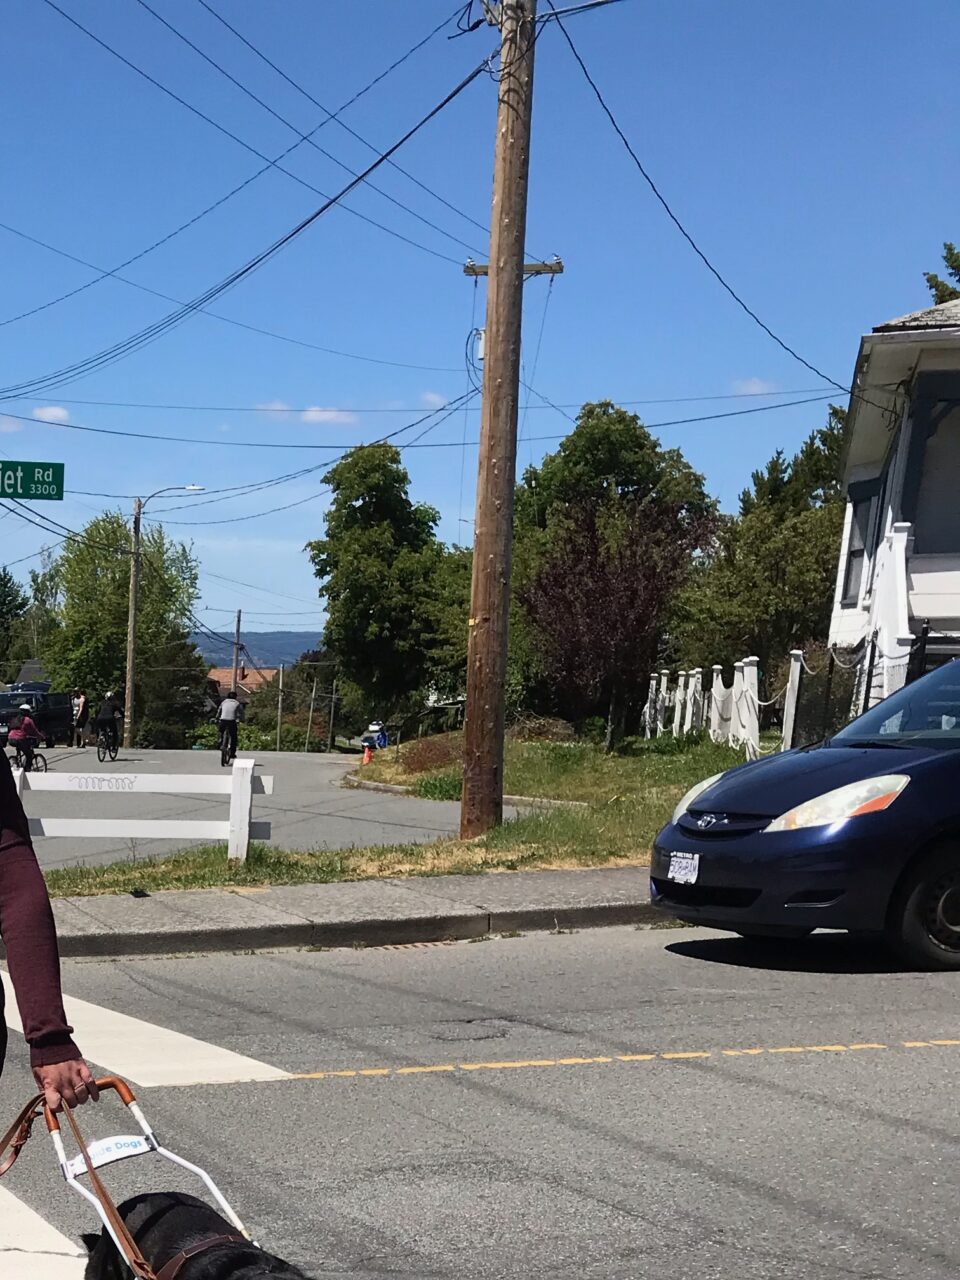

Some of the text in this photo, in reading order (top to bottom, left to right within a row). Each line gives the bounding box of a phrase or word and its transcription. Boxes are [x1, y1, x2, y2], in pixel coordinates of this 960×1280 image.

[34, 468, 53, 482] Rd
[29, 483, 57, 495] 3300
[114, 1139, 142, 1150] Dogs
